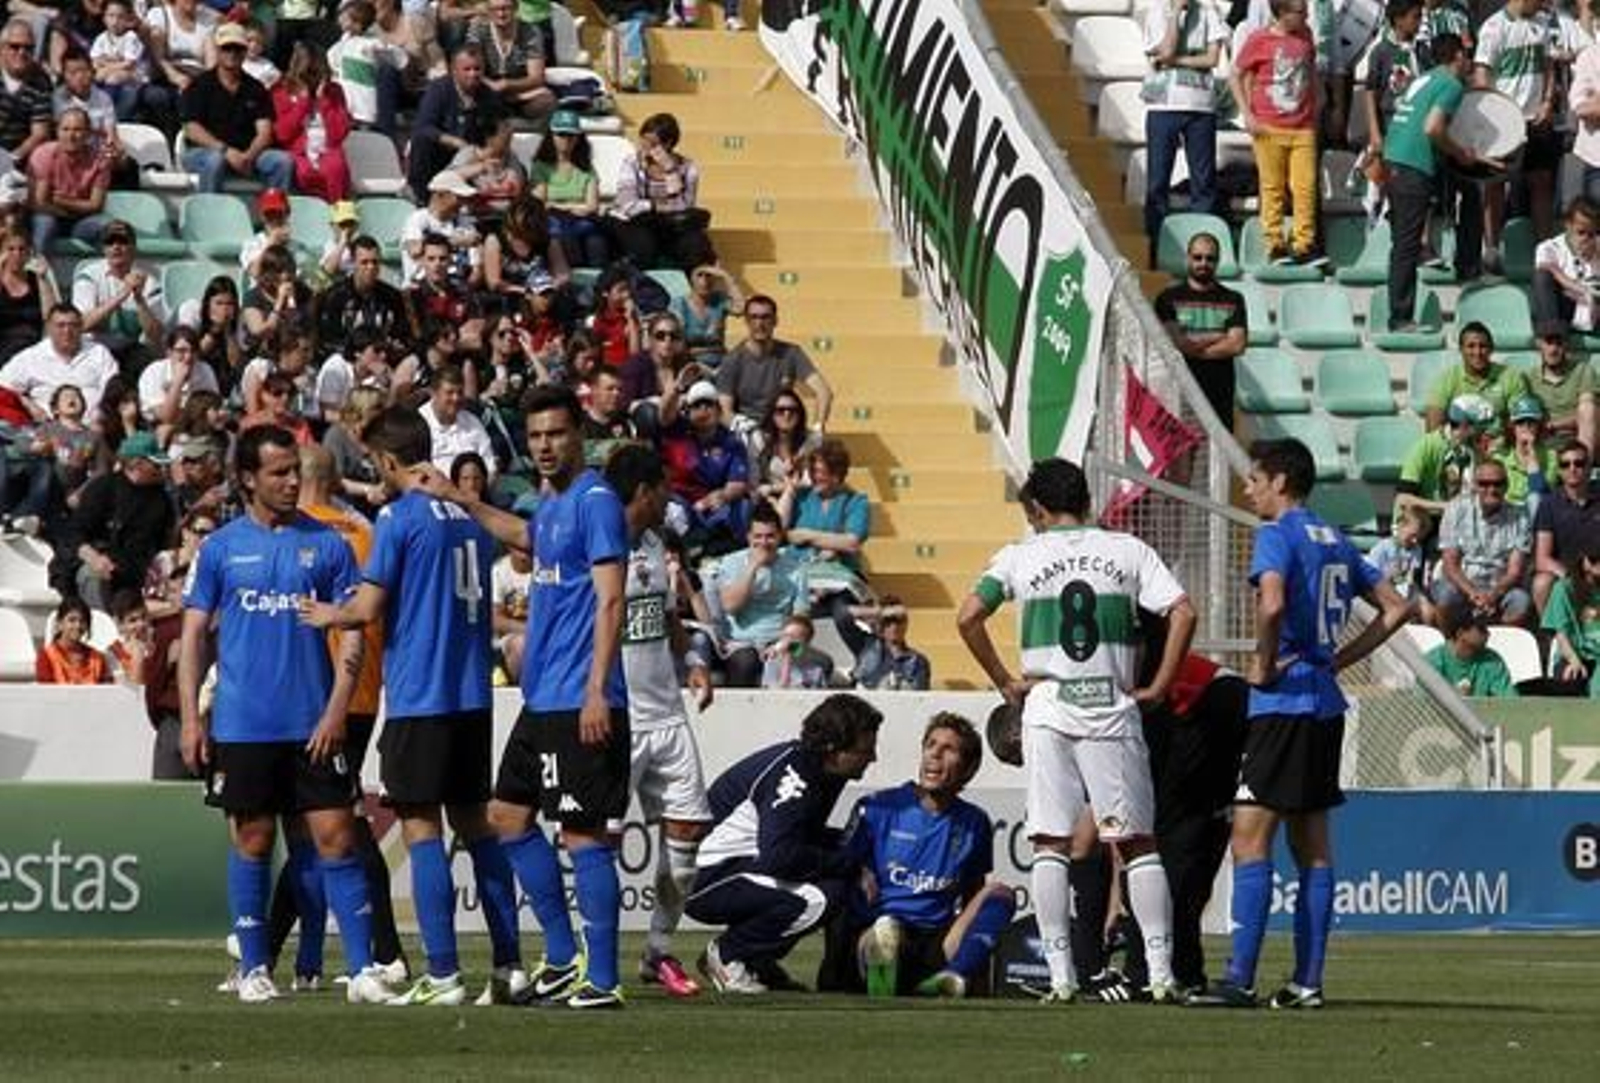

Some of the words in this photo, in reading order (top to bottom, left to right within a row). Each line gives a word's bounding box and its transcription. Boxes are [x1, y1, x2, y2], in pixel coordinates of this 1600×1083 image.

[239, 588, 318, 617] Cajasl
[453, 539, 483, 624] 4
[1059, 579, 1100, 663] 8
[540, 752, 559, 788] 21
